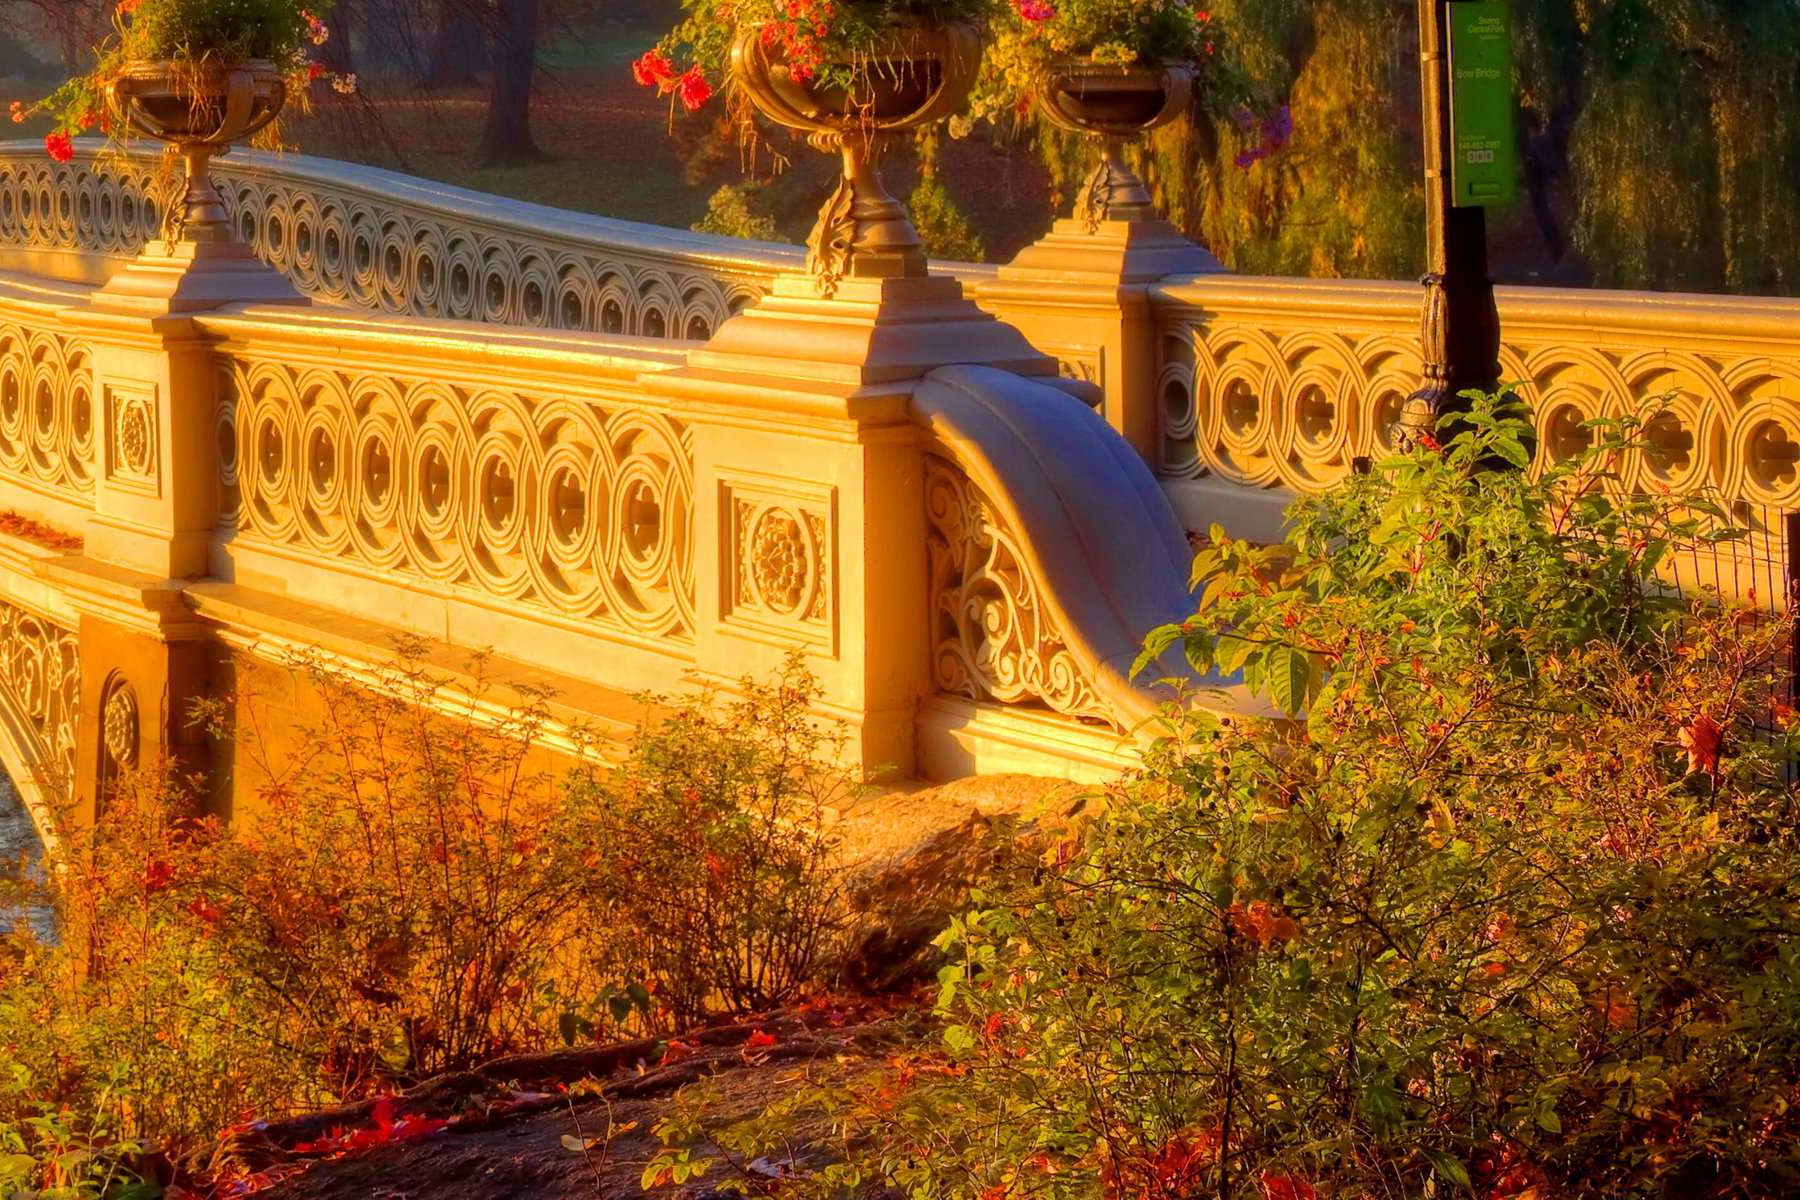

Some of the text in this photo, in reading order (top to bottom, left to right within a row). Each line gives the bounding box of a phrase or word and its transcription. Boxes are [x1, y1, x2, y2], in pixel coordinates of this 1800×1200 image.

[1478, 16, 1500, 26] Seeing
[1467, 24, 1505, 33] Central Park
[1456, 67, 1501, 80] Bow Bridge
